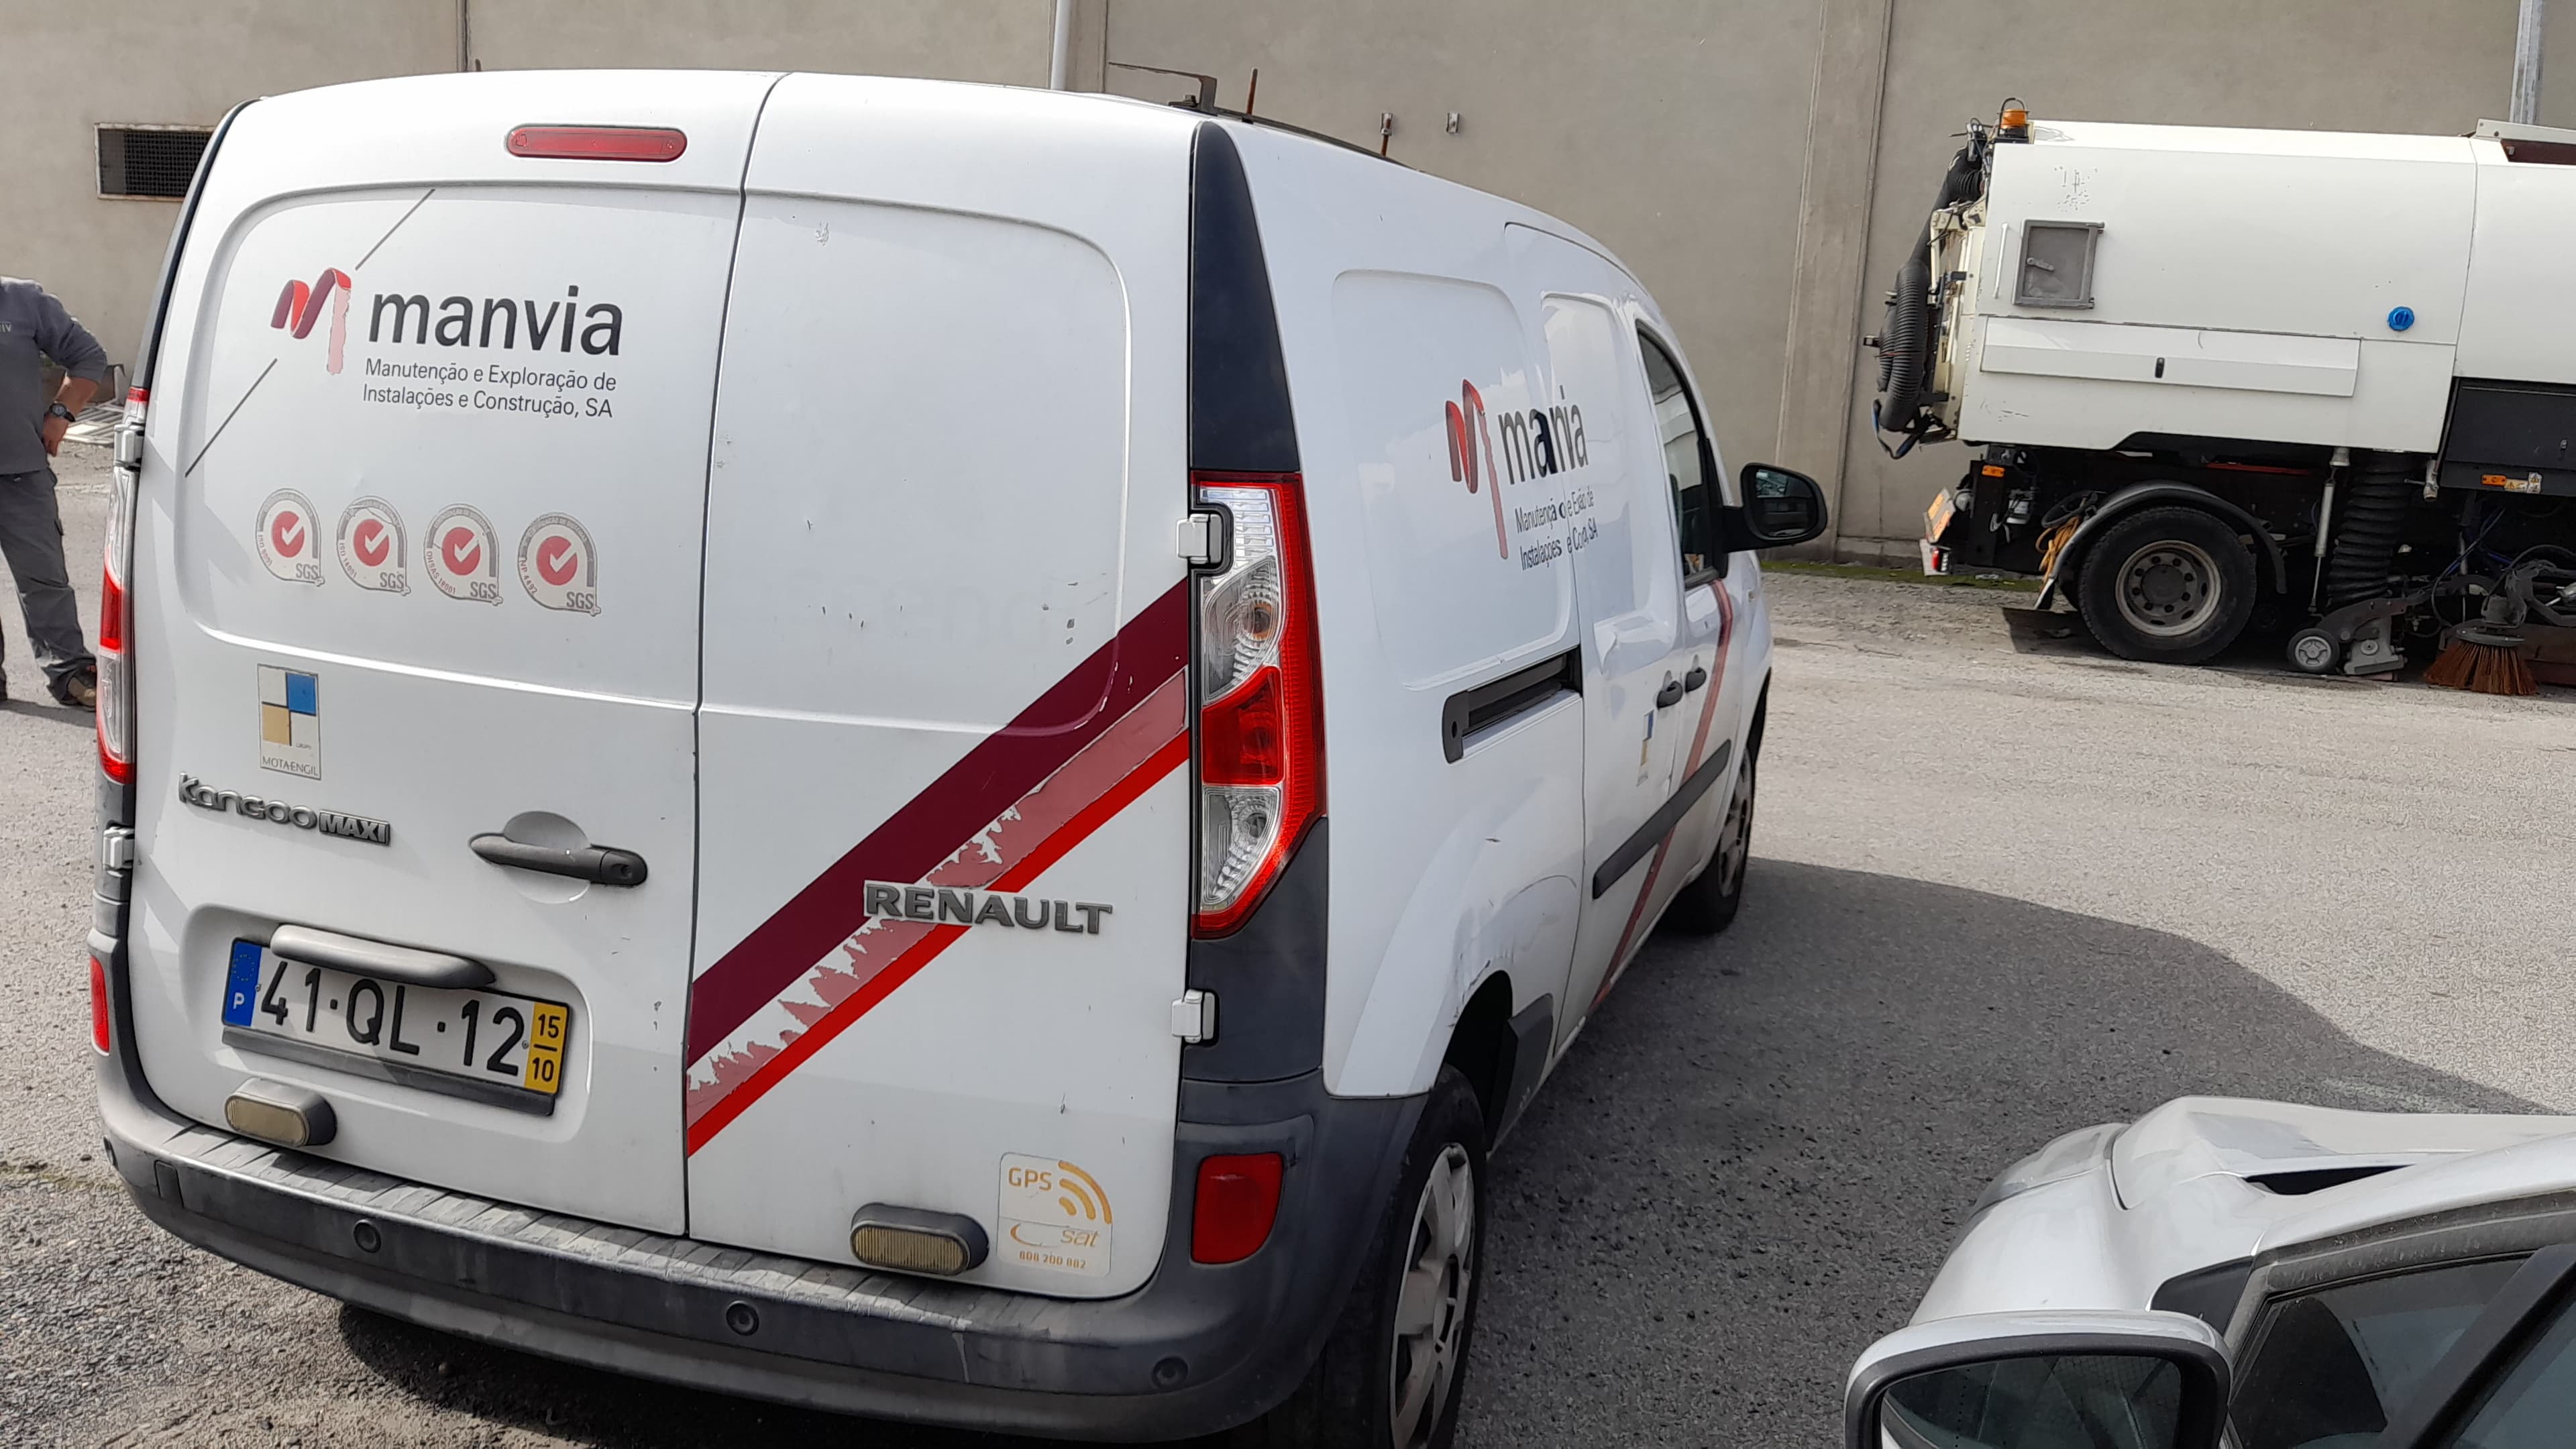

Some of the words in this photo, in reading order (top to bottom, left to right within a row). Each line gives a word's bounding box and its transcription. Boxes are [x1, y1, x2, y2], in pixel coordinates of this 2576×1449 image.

[369, 285, 623, 356] manvia
[366, 358, 468, 384] Manutenção
[474, 369, 484, 382] e
[488, 365, 588, 392] Exploração
[594, 372, 616, 391] de
[363, 383, 453, 411] Instalações
[458, 394, 469, 408] e
[474, 390, 579, 419] Construção,
[585, 398, 613, 418] SA
[296, 562, 319, 580] SGS
[426, 551, 441, 580] OHSAS
[380, 572, 405, 590] SGS
[470, 581, 497, 599] SGS
[566, 591, 594, 610] SGS
[178, 772, 317, 828] Kangoo
[320, 810, 390, 845] MAXI
[865, 883, 1114, 934] RENAULT
[233, 991, 246, 1010] P
[537, 1013, 560, 1040] 15
[532, 1056, 555, 1083] 10
[1008, 1167, 1053, 1191] GPS
